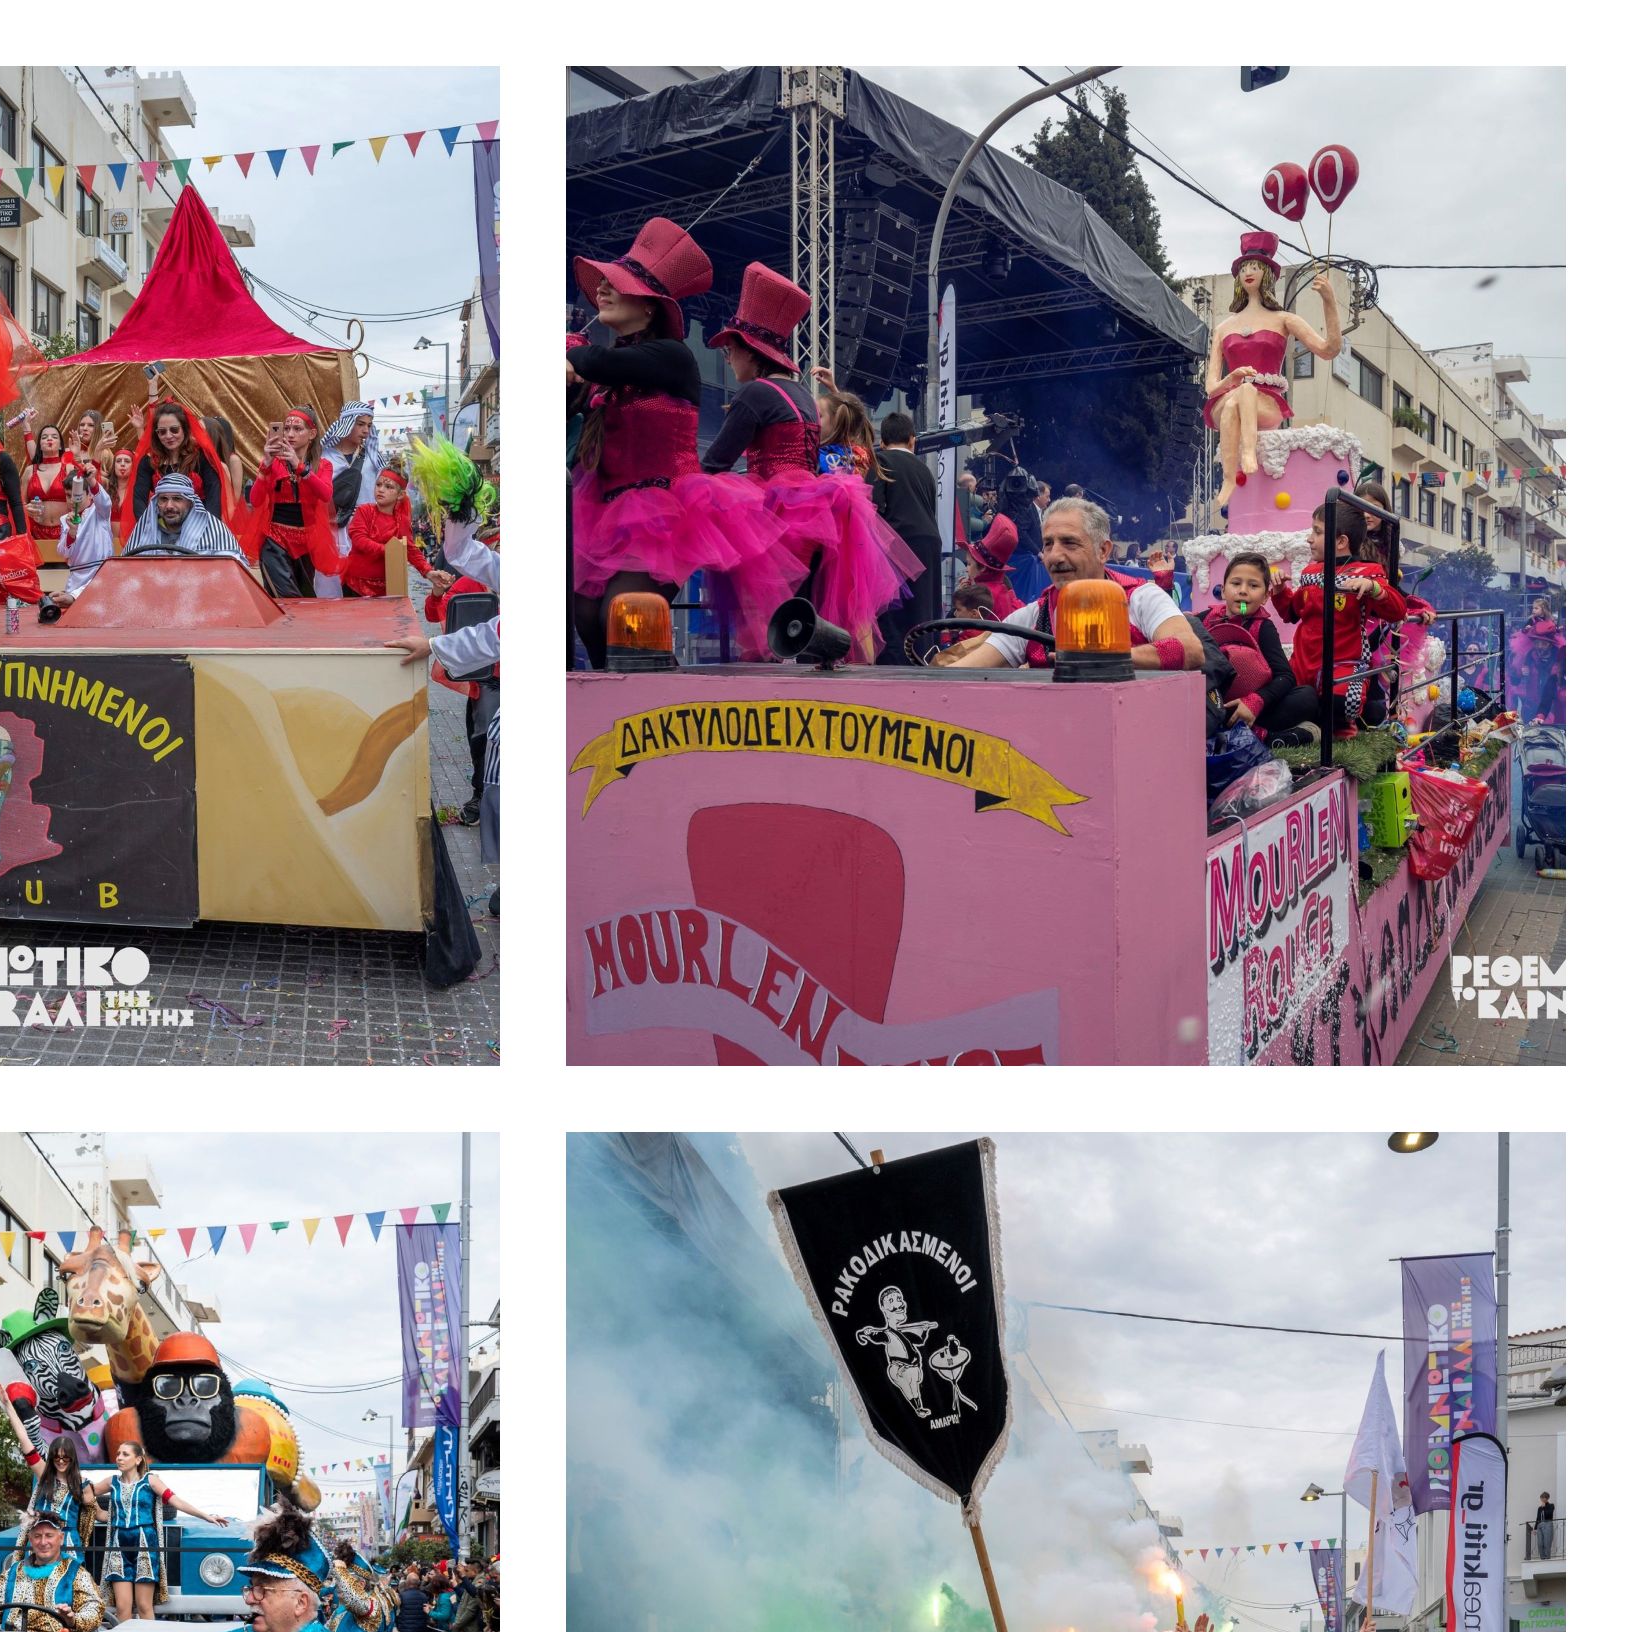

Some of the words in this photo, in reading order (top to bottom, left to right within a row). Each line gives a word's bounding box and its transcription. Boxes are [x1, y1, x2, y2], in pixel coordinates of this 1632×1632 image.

[621, 706, 975, 778] ΔΑΚΤΥΛΟΔΕΙΧΤΟΥΜΕΝΟΙ
[1210, 781, 1351, 970] MOURLEN
[584, 909, 846, 1064] MOURLEN
[831, 1230, 978, 1318] ΡΑΚΟΔΙΚΑΣΜΕΝΟΙ
